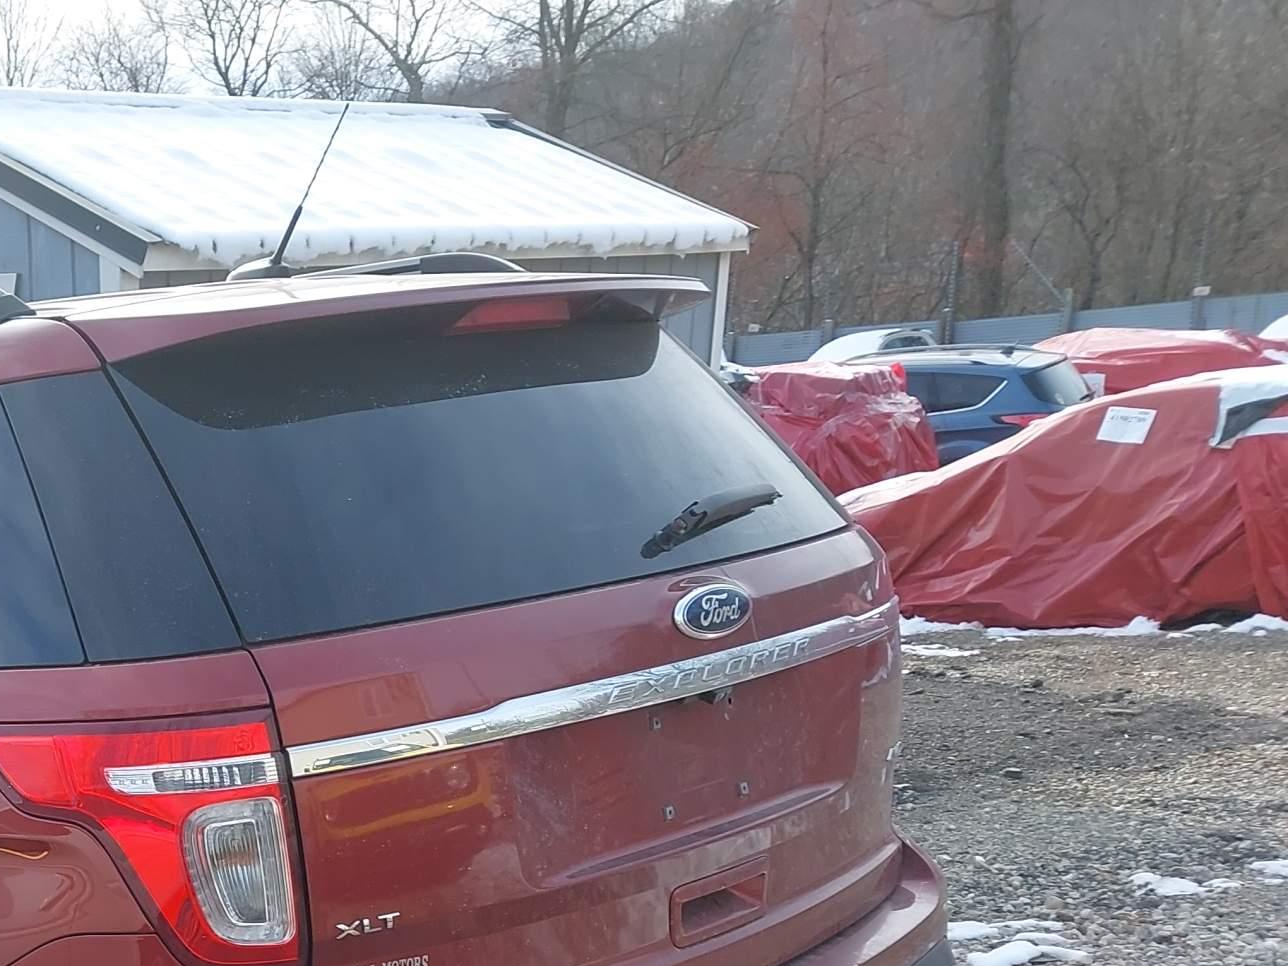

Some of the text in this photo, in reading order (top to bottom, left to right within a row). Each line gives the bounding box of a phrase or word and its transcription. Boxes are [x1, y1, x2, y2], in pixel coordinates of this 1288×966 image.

[700, 592, 741, 627] Ford
[608, 637, 811, 705] EXPLORER
[335, 911, 401, 940] XLT
